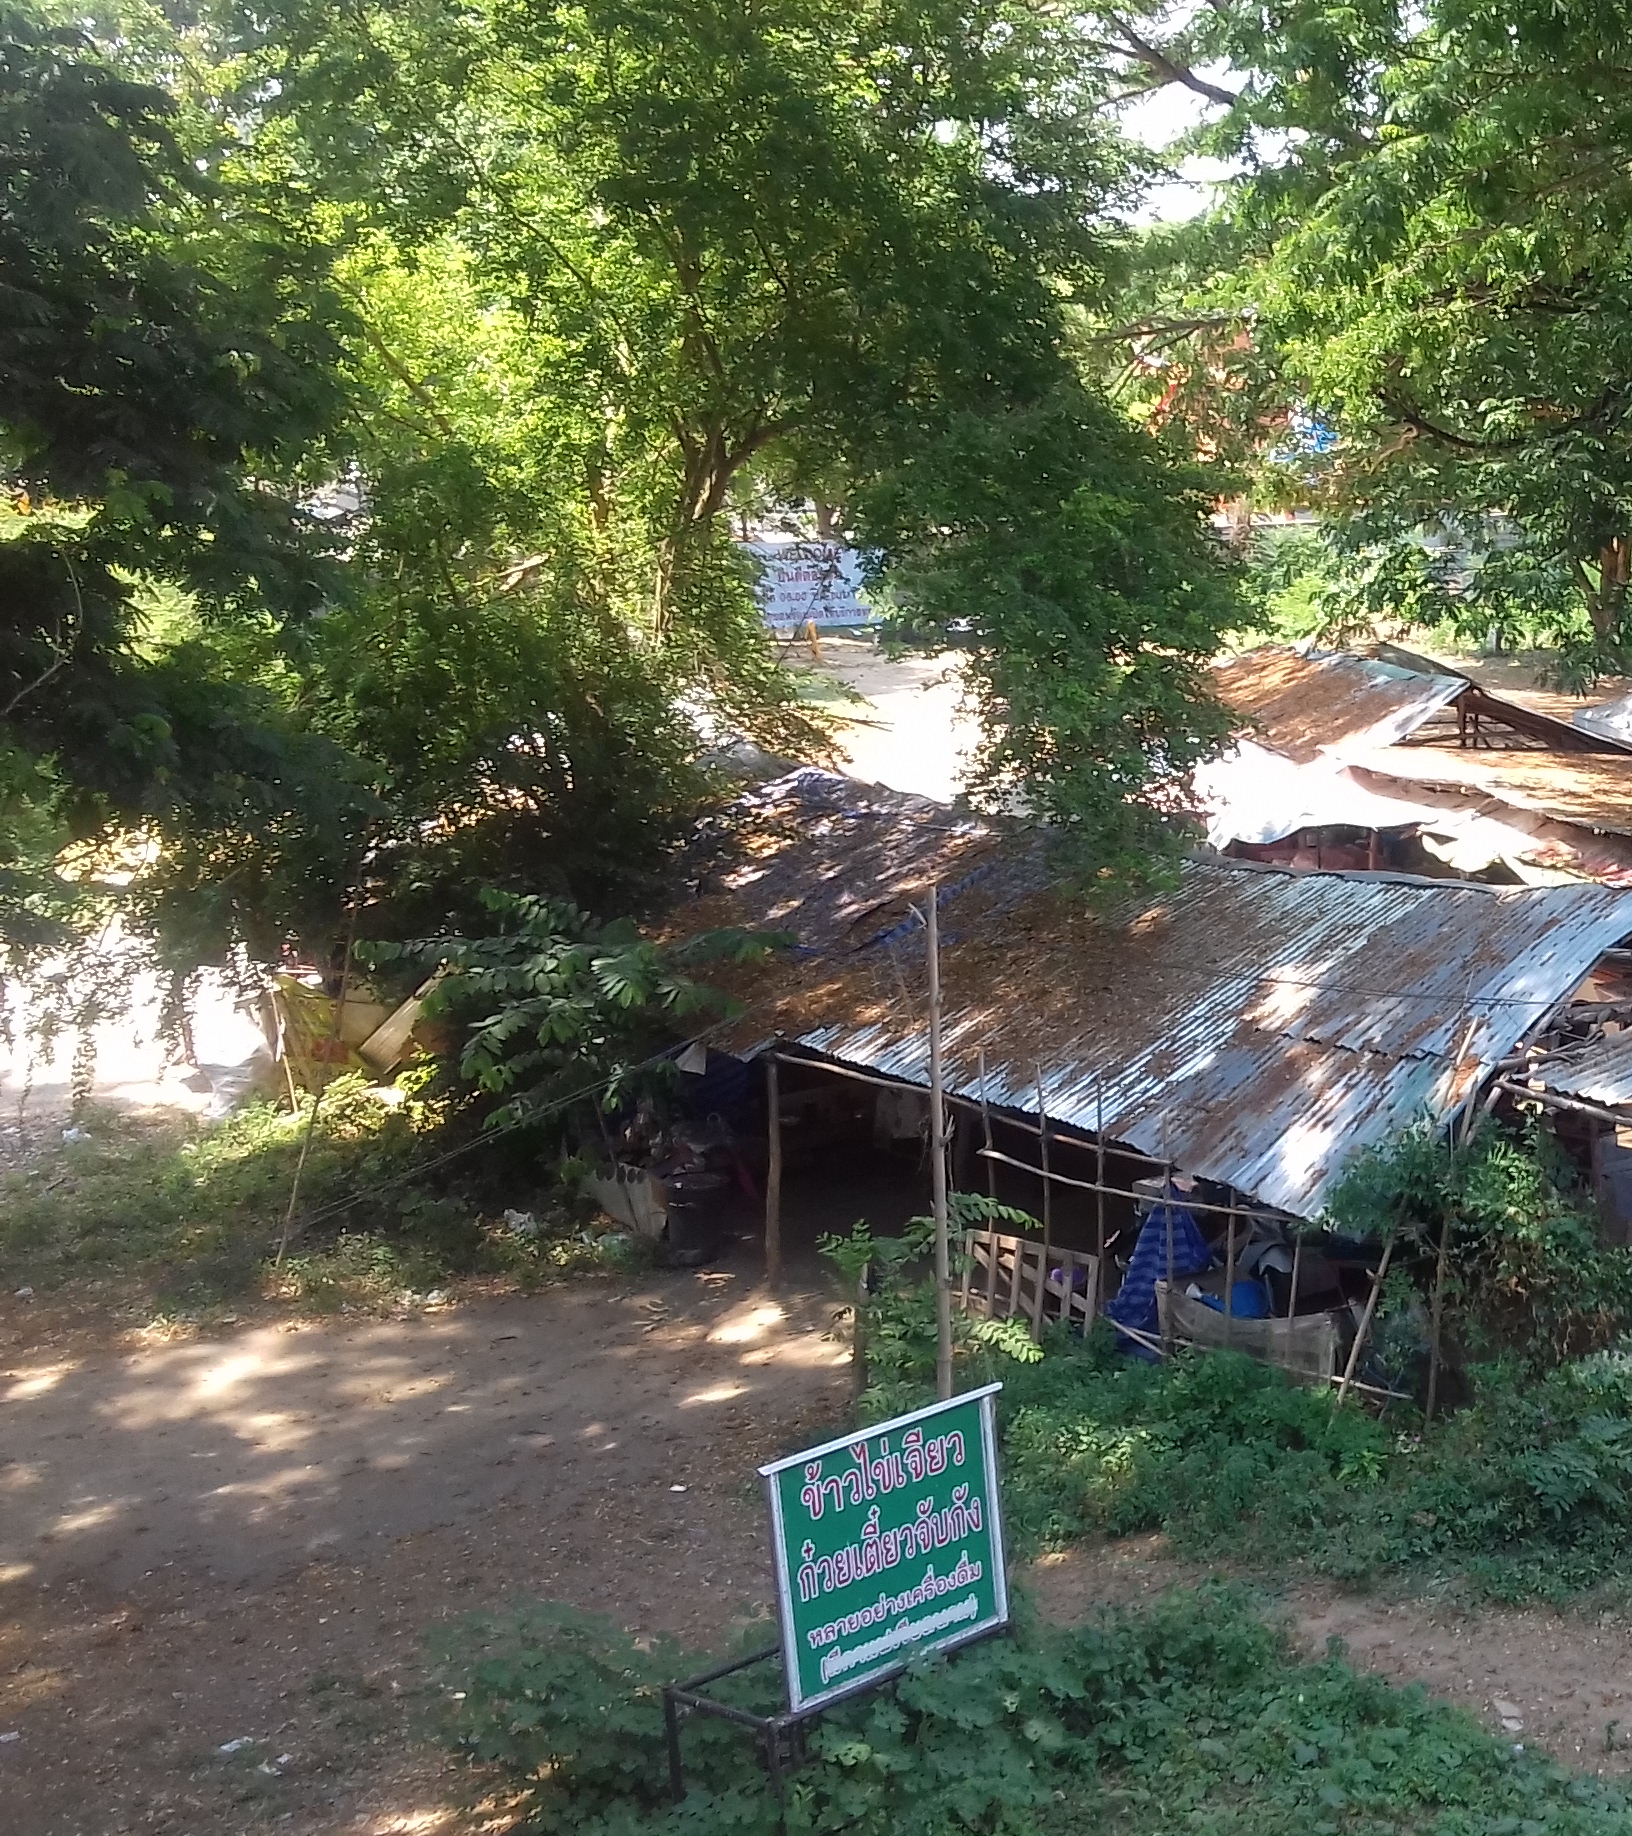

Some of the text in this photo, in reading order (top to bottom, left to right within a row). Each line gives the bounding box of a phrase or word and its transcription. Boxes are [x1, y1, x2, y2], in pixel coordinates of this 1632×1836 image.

[802, 1427, 965, 1520] ข้าวไข่เจียว
[798, 1484, 983, 1601] ก๋วยเตี๋ยวจับกัง
[808, 1550, 982, 1648] หลายอย่างเครื่องดื่ม
